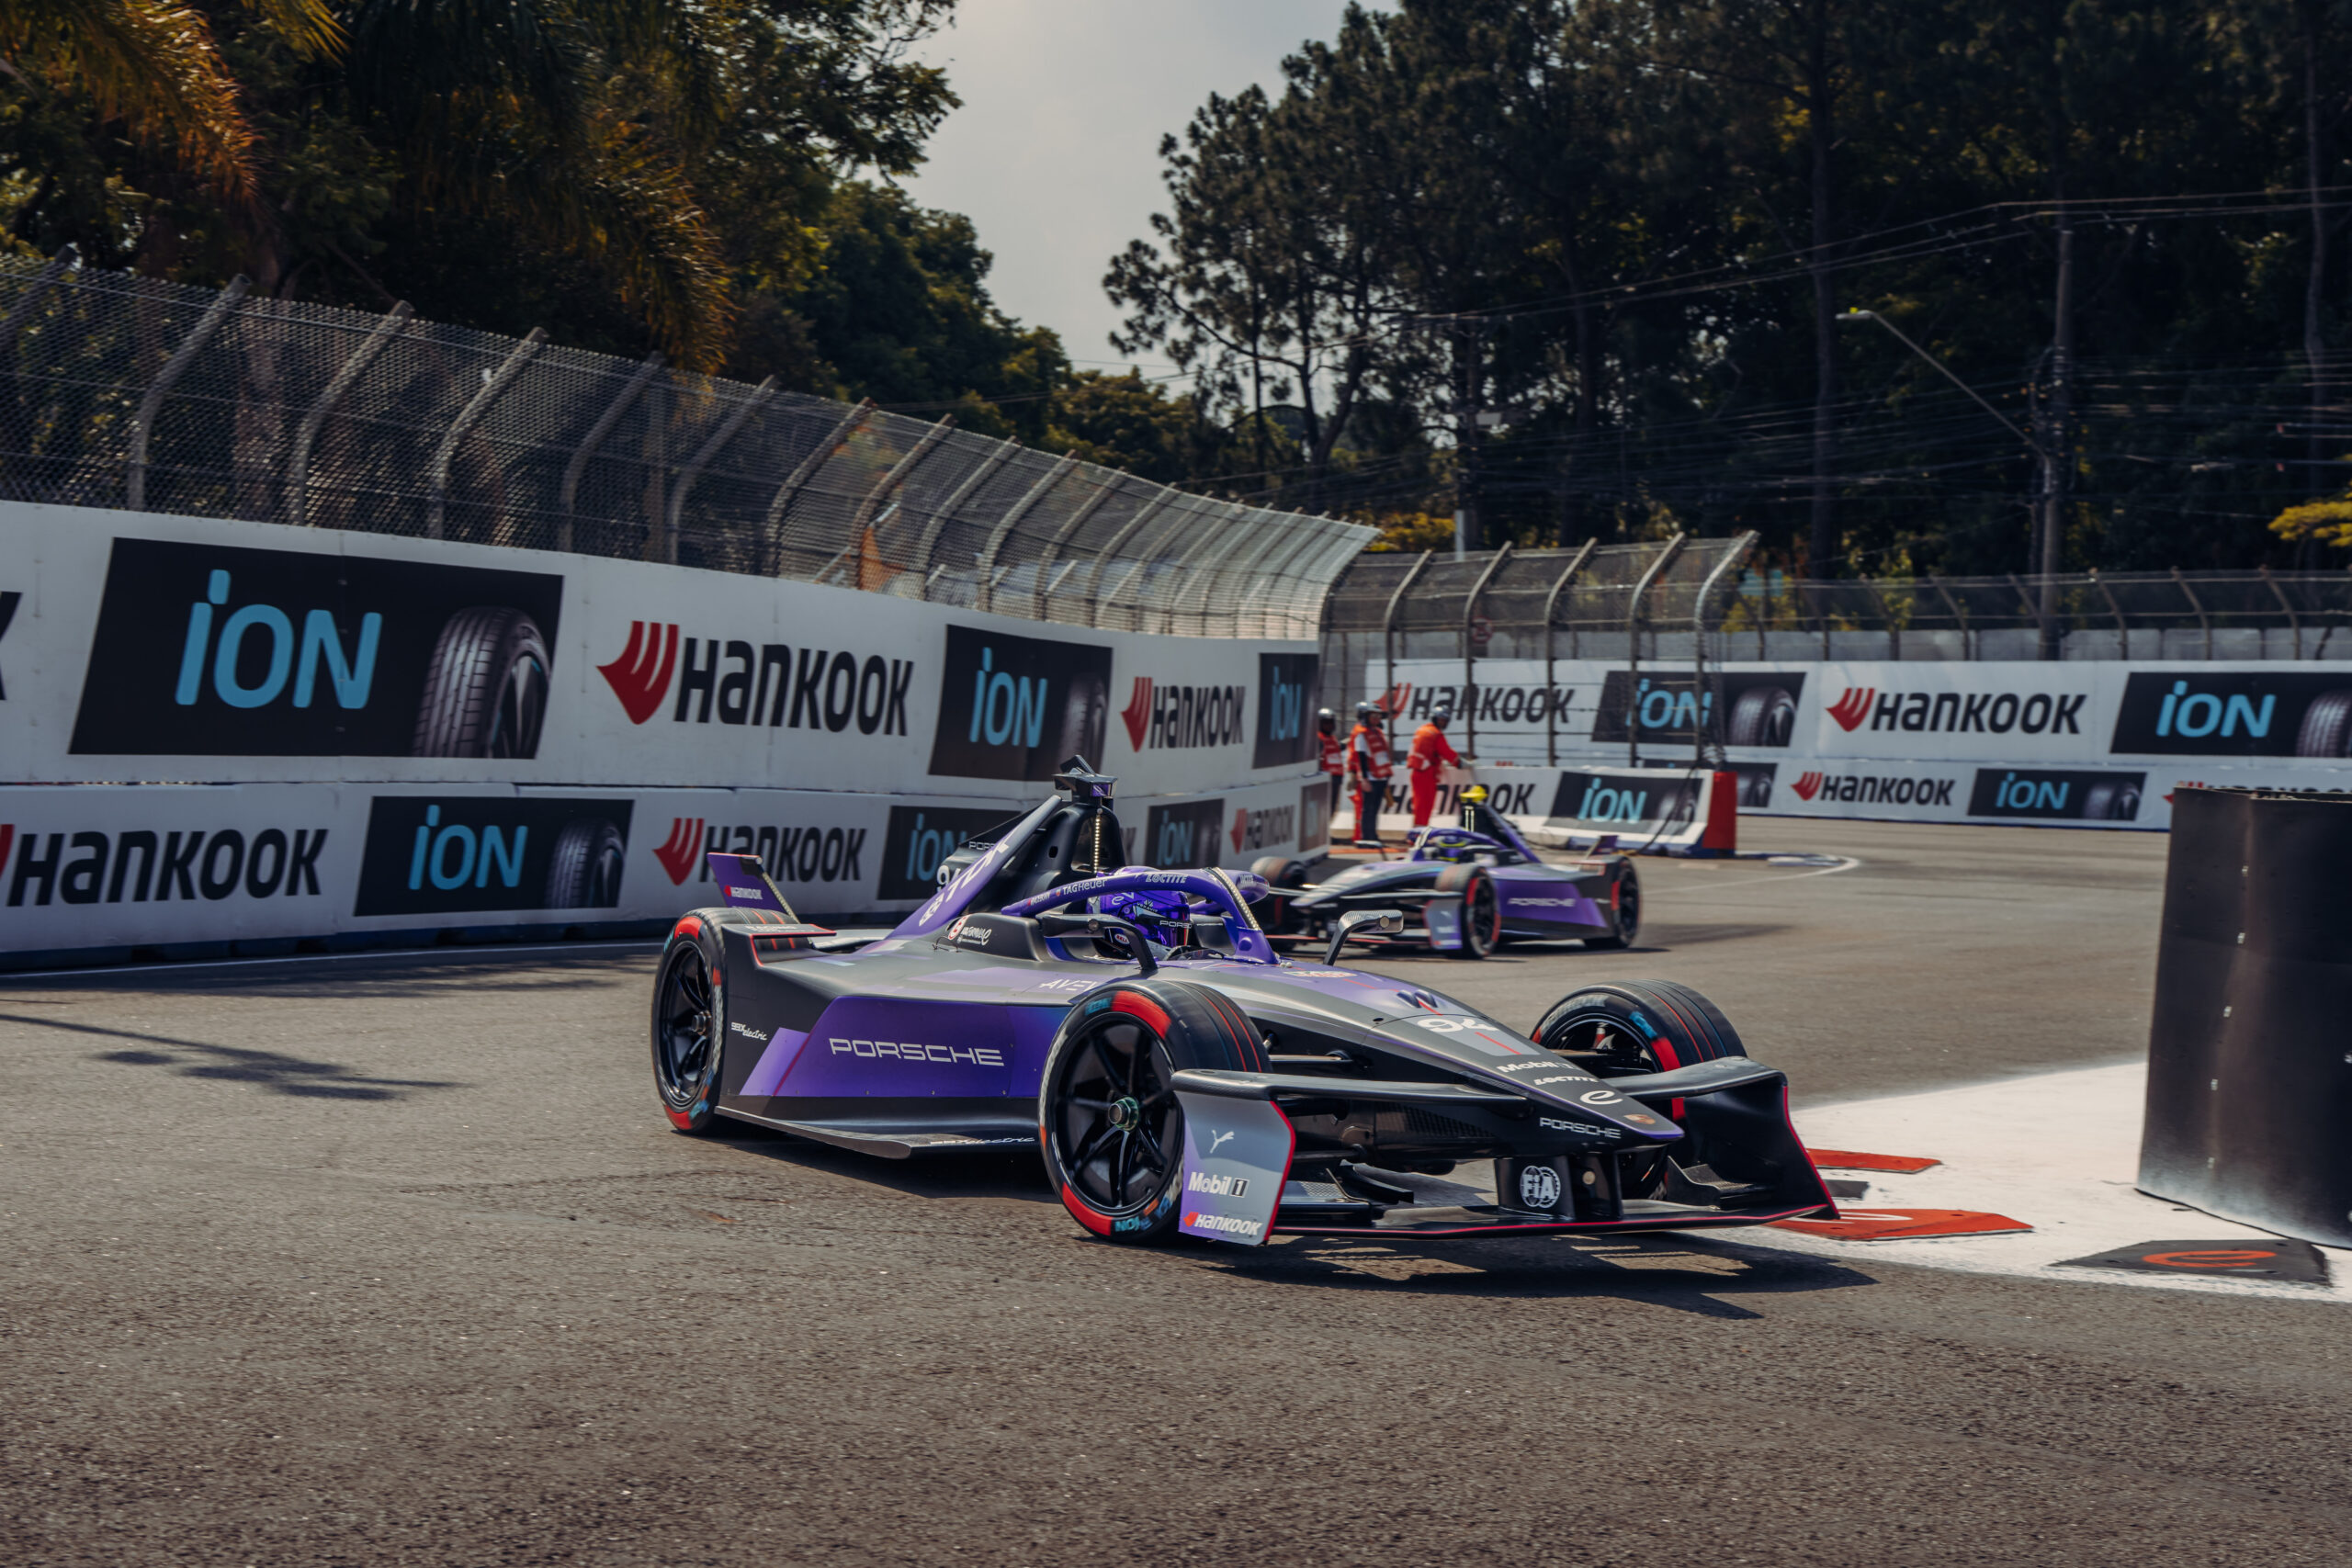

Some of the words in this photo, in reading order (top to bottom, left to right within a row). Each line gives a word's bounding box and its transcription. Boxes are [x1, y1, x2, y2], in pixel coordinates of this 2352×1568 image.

[175, 570, 382, 708] iON
[969, 647, 1047, 748] iON
[2156, 681, 2276, 737] iON
[408, 805, 527, 890] iON
[1146, 874, 1189, 884] LOCTITE
[829, 1038, 1004, 1066] PORSCHE
[1497, 1061, 1560, 1073] Mobil
[1539, 1117, 1621, 1139] PORSCHE
[1188, 1171, 1231, 1195] Mobil
